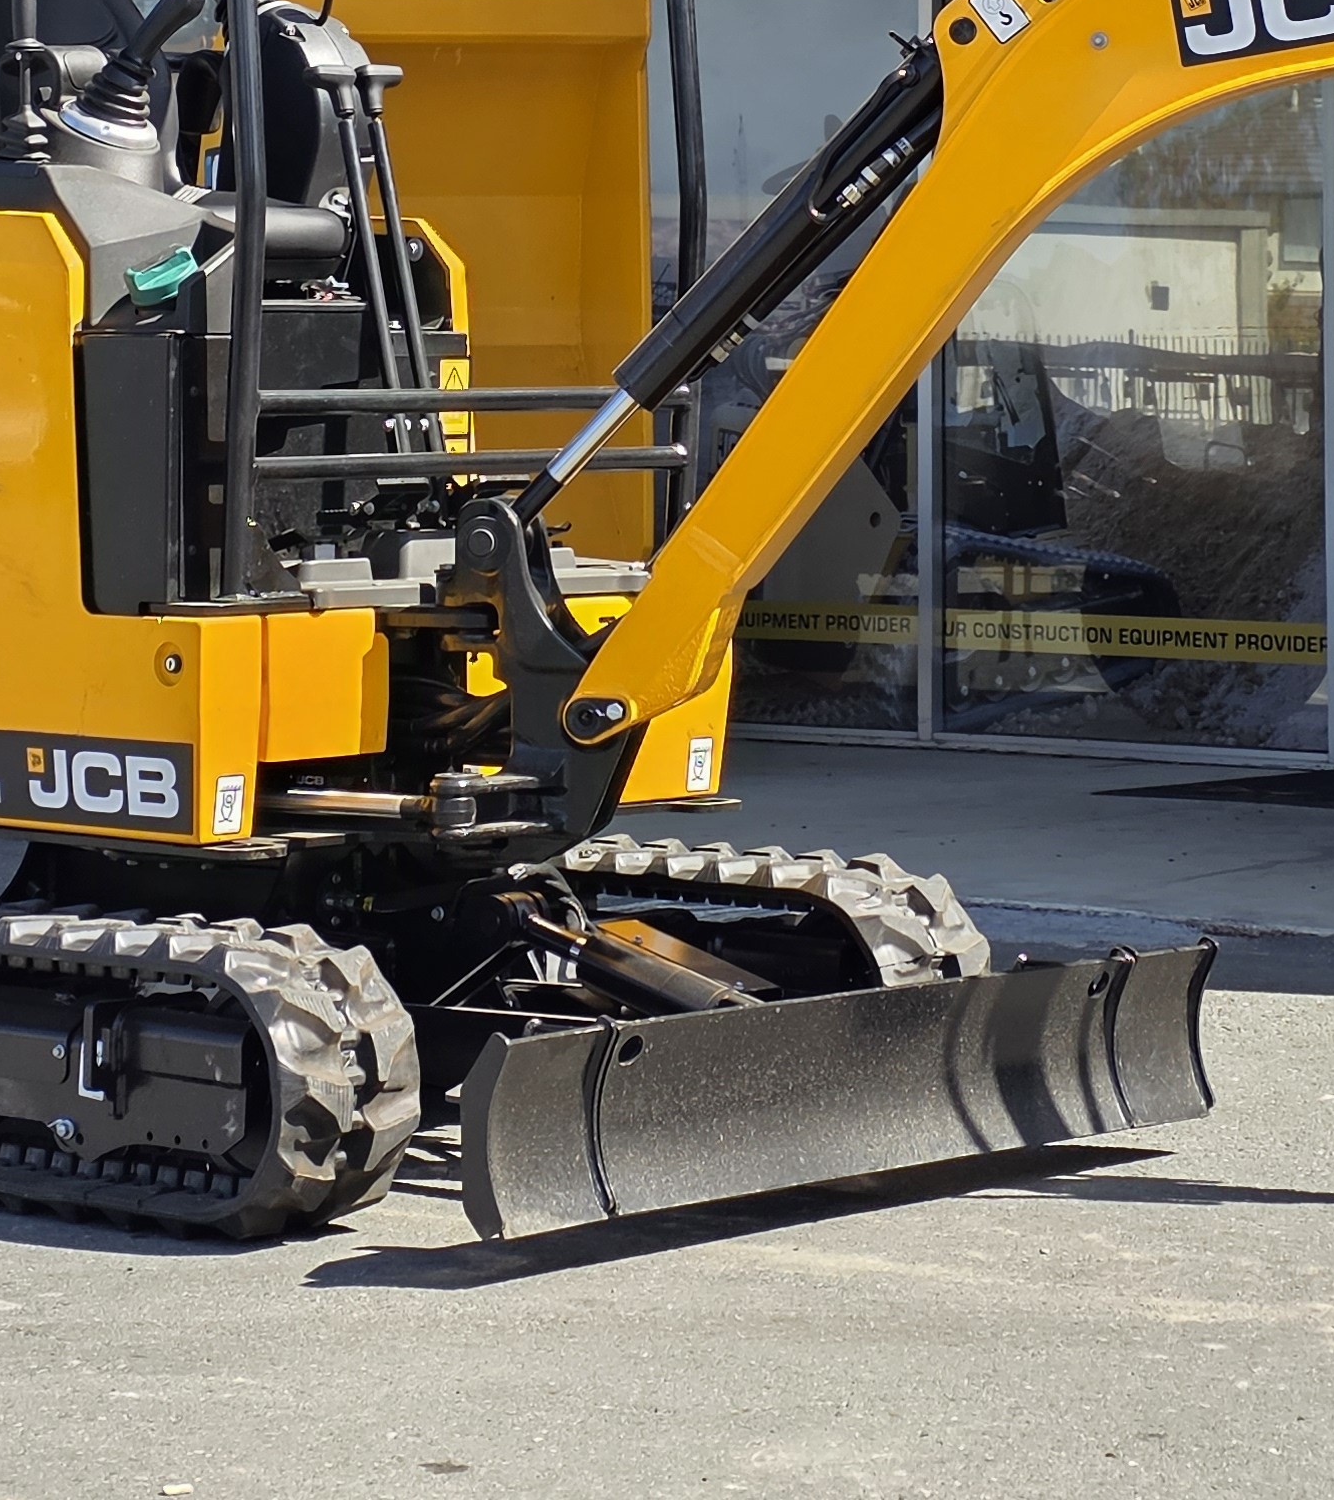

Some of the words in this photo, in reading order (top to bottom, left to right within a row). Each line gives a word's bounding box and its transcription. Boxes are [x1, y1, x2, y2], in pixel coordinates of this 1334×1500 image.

[825, 614, 911, 633] PROVIDER
[973, 622, 1112, 644] CONSTRUCTION
[1118, 628, 1228, 649] EQUIPMENT
[29, 749, 179, 818] JCB
[297, 775, 325, 786] JCB
